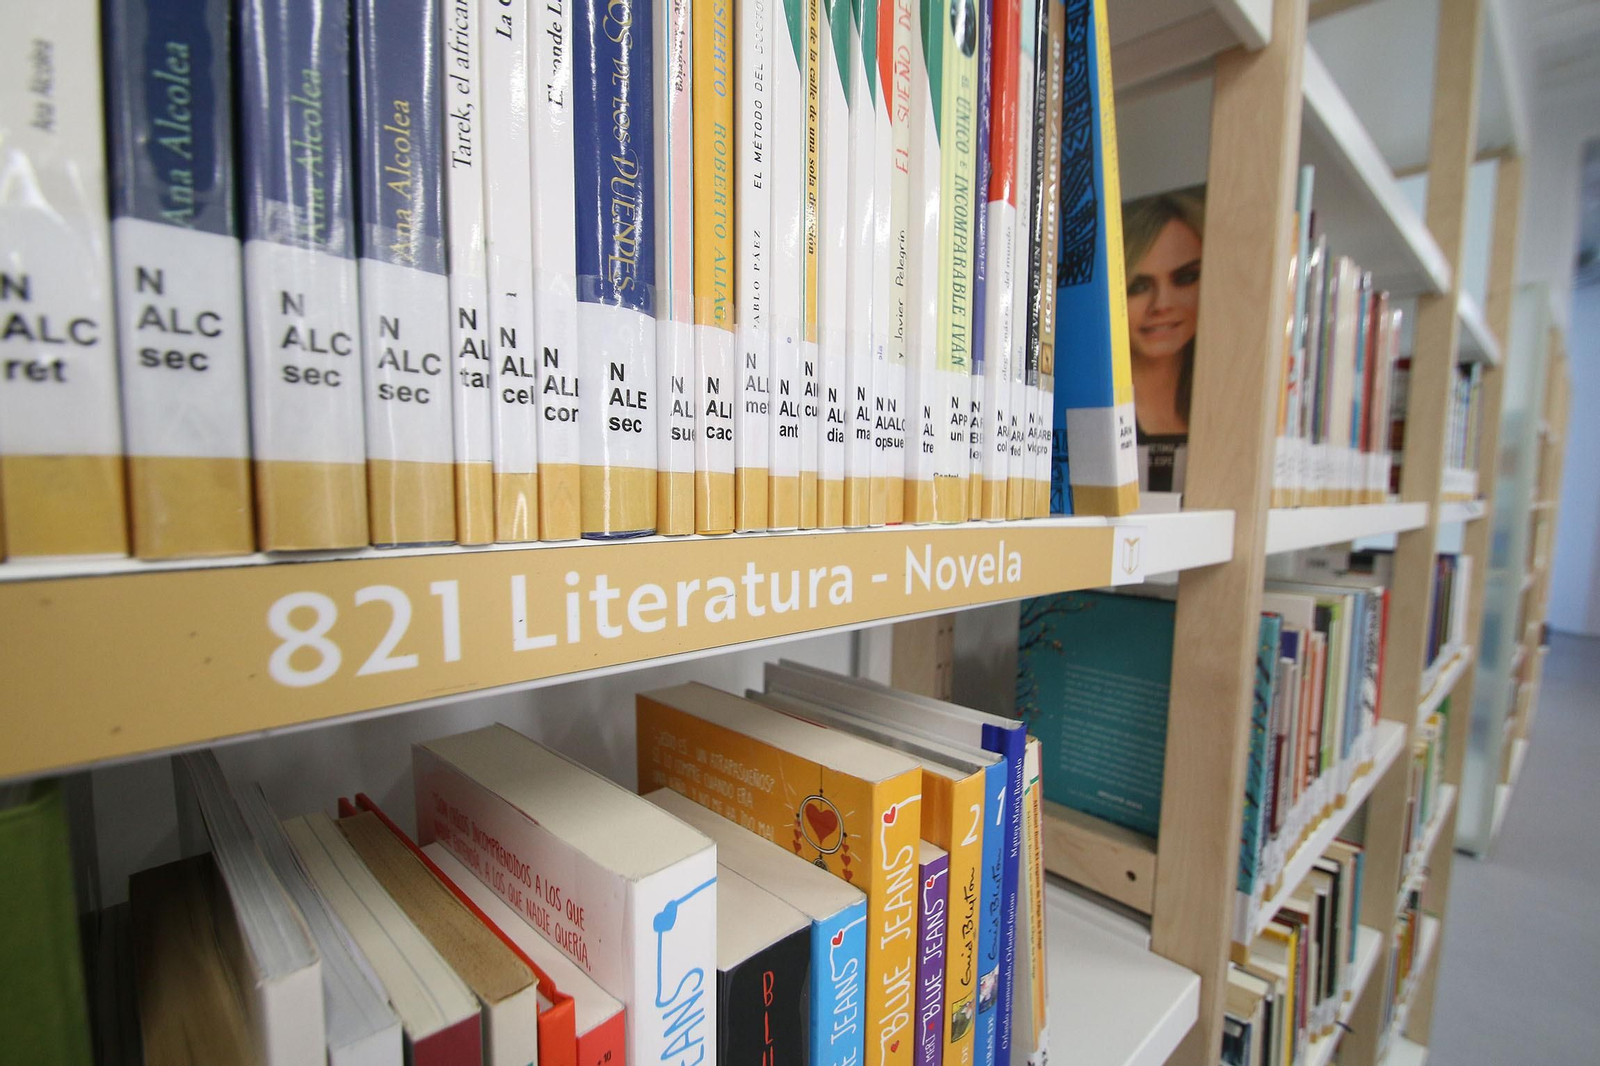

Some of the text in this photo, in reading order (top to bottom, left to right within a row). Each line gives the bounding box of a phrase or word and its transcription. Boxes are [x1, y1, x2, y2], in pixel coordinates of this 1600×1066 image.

[495, 14, 513, 41] La
[753, 0, 764, 54] DOCTO
[810, 26, 818, 45] de
[809, 48, 818, 63] la
[612, 56, 631, 89] DE
[754, 63, 764, 92] DEL
[808, 67, 818, 100] calle
[894, 45, 911, 127] SUEÑO
[449, 75, 476, 169] Tarek, el
[611, 96, 631, 143] LOS
[808, 104, 818, 122] de
[955, 95, 973, 155] ÚNICO
[152, 41, 197, 229] Ana Alcolea
[289, 68, 326, 188] Alcolea
[751, 99, 763, 164] MÉTODO
[808, 127, 817, 153] una
[383, 99, 412, 194] Alcolea
[713, 0, 727, 331] SIERTO ROBERTO ALIAG
[808, 158, 817, 187] sola
[895, 147, 910, 175] EL
[753, 171, 763, 190] EL
[607, 148, 639, 291] DUENDES
[751, 229, 762, 272] PÁEZ
[895, 229, 907, 287] Pelegrín
[951, 173, 972, 317] INCOMPARABLE
[0, 272, 30, 301] N
[136, 265, 164, 296] N
[280, 290, 305, 317] N
[1, 311, 98, 346] ALC
[137, 303, 223, 338] ALC
[379, 314, 400, 340] N
[458, 306, 478, 331] N
[894, 297, 905, 343] Javier
[280, 324, 353, 357] ALC
[499, 326, 516, 349] N
[950, 322, 969, 368] IVÁN
[4, 357, 67, 383] ret
[139, 346, 210, 372] sec
[377, 346, 442, 377] ALC
[543, 346, 559, 369] N
[745, 352, 757, 370] N
[804, 360, 814, 377] N
[281, 364, 341, 388] sec
[609, 361, 626, 382] N
[670, 375, 684, 394] N
[377, 381, 431, 405] sec
[501, 385, 536, 405] cel
[608, 387, 648, 411] ALE
[706, 376, 720, 396] N
[779, 378, 790, 396] N
[828, 387, 838, 403] N
[857, 386, 866, 401] N
[705, 399, 733, 420] ALI
[876, 396, 884, 411] N
[887, 398, 897, 413] N
[923, 405, 931, 420] N
[951, 396, 960, 409] N
[970, 401, 981, 413] N
[997, 410, 1004, 421] N
[607, 415, 643, 434] sec
[778, 423, 799, 438] ant
[950, 412, 969, 427] APP
[1011, 415, 1018, 427] N
[1029, 412, 1035, 423] N
[705, 425, 733, 442] cac
[826, 427, 844, 443] dia
[922, 440, 934, 454] tre
[266, 579, 462, 690] 821
[509, 560, 853, 654] Literatura
[904, 540, 1022, 595] Novela
[995, 786, 1007, 827] 1
[960, 803, 981, 848] 2
[1010, 825, 1021, 859] Matteo
[491, 864, 506, 896] LOS
[508, 882, 523, 913] QUE
[526, 897, 551, 936] NADIE
[535, 874, 542, 898] A
[544, 879, 562, 913] LOS
[565, 898, 585, 932] QUE
[878, 844, 914, 1044] BLUE JEANS
[921, 898, 945, 1024] BLUE JEANS
[830, 957, 859, 1046] JEANS
[1001, 1012, 1011, 1050] Orlando
